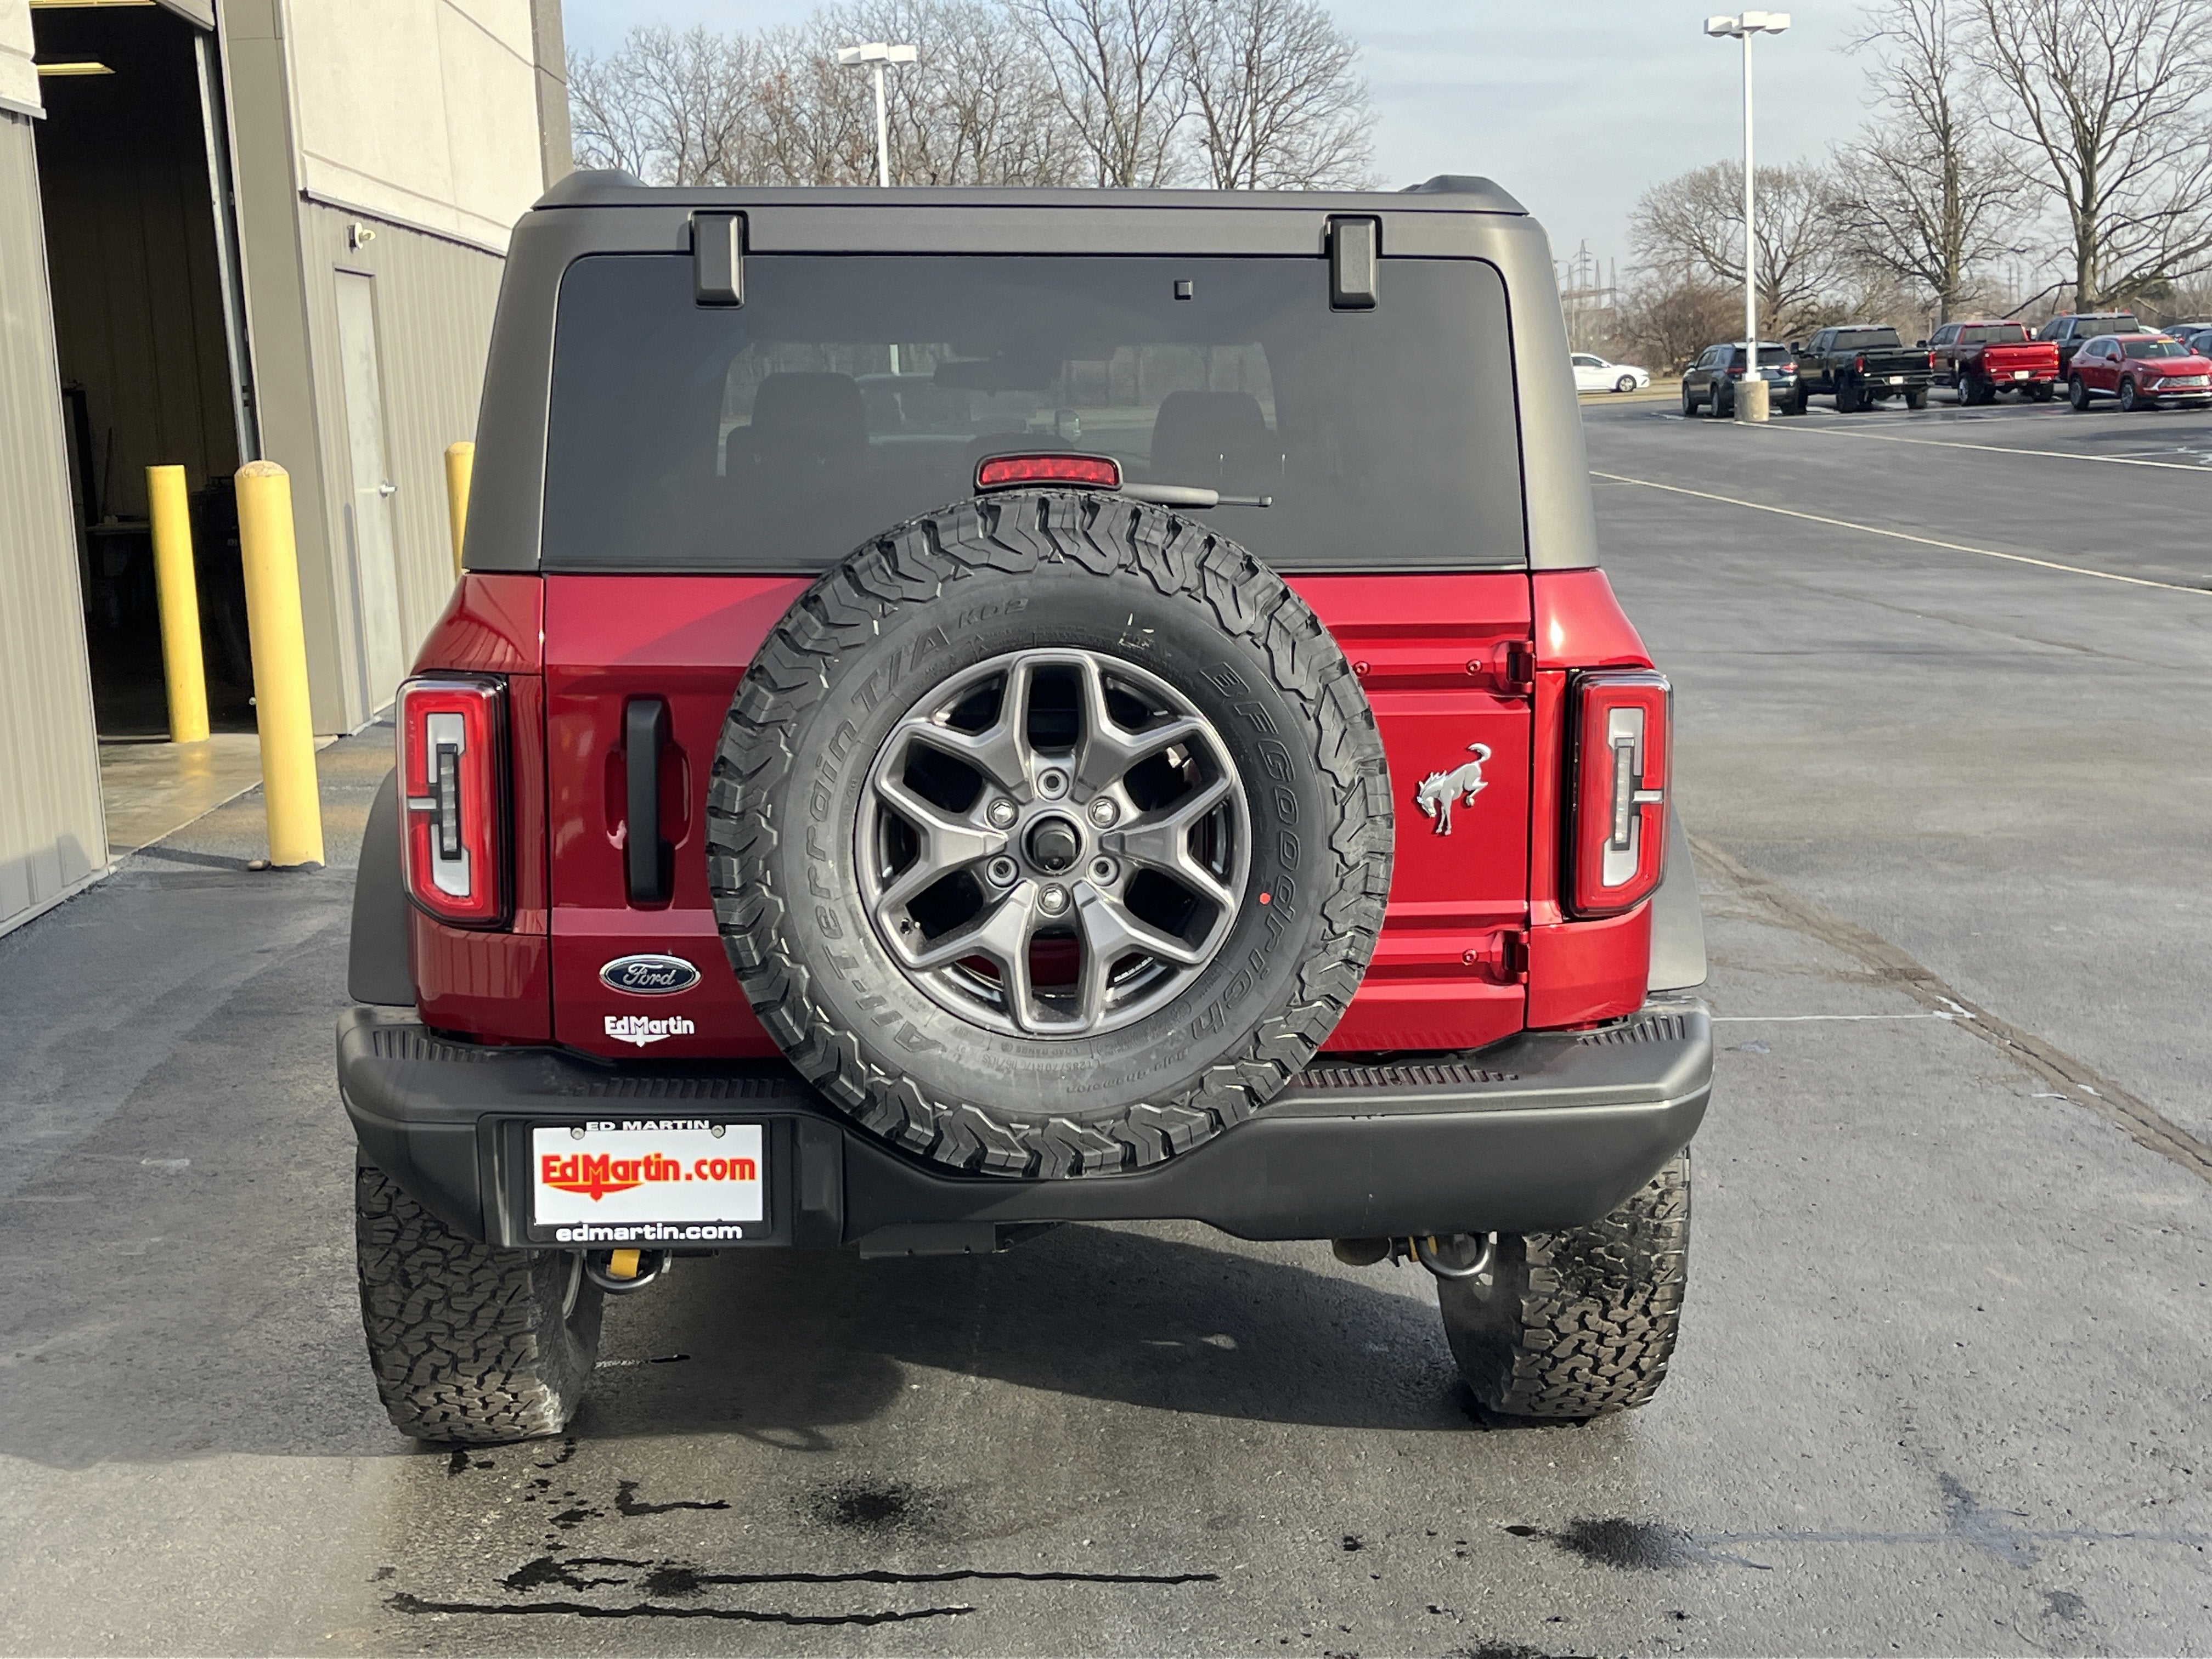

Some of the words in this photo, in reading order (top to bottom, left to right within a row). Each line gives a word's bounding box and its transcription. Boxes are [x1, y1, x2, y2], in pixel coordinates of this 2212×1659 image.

[851, 625, 951, 712] T/A
[1192, 662, 1300, 1040] BFGoodrich
[806, 719, 946, 1052] All-Terrain
[623, 963, 676, 985] Ford
[586, 1121, 616, 1131] ED
[623, 1120, 709, 1130] MARTIN
[556, 1223, 742, 1242] edmartin.com
